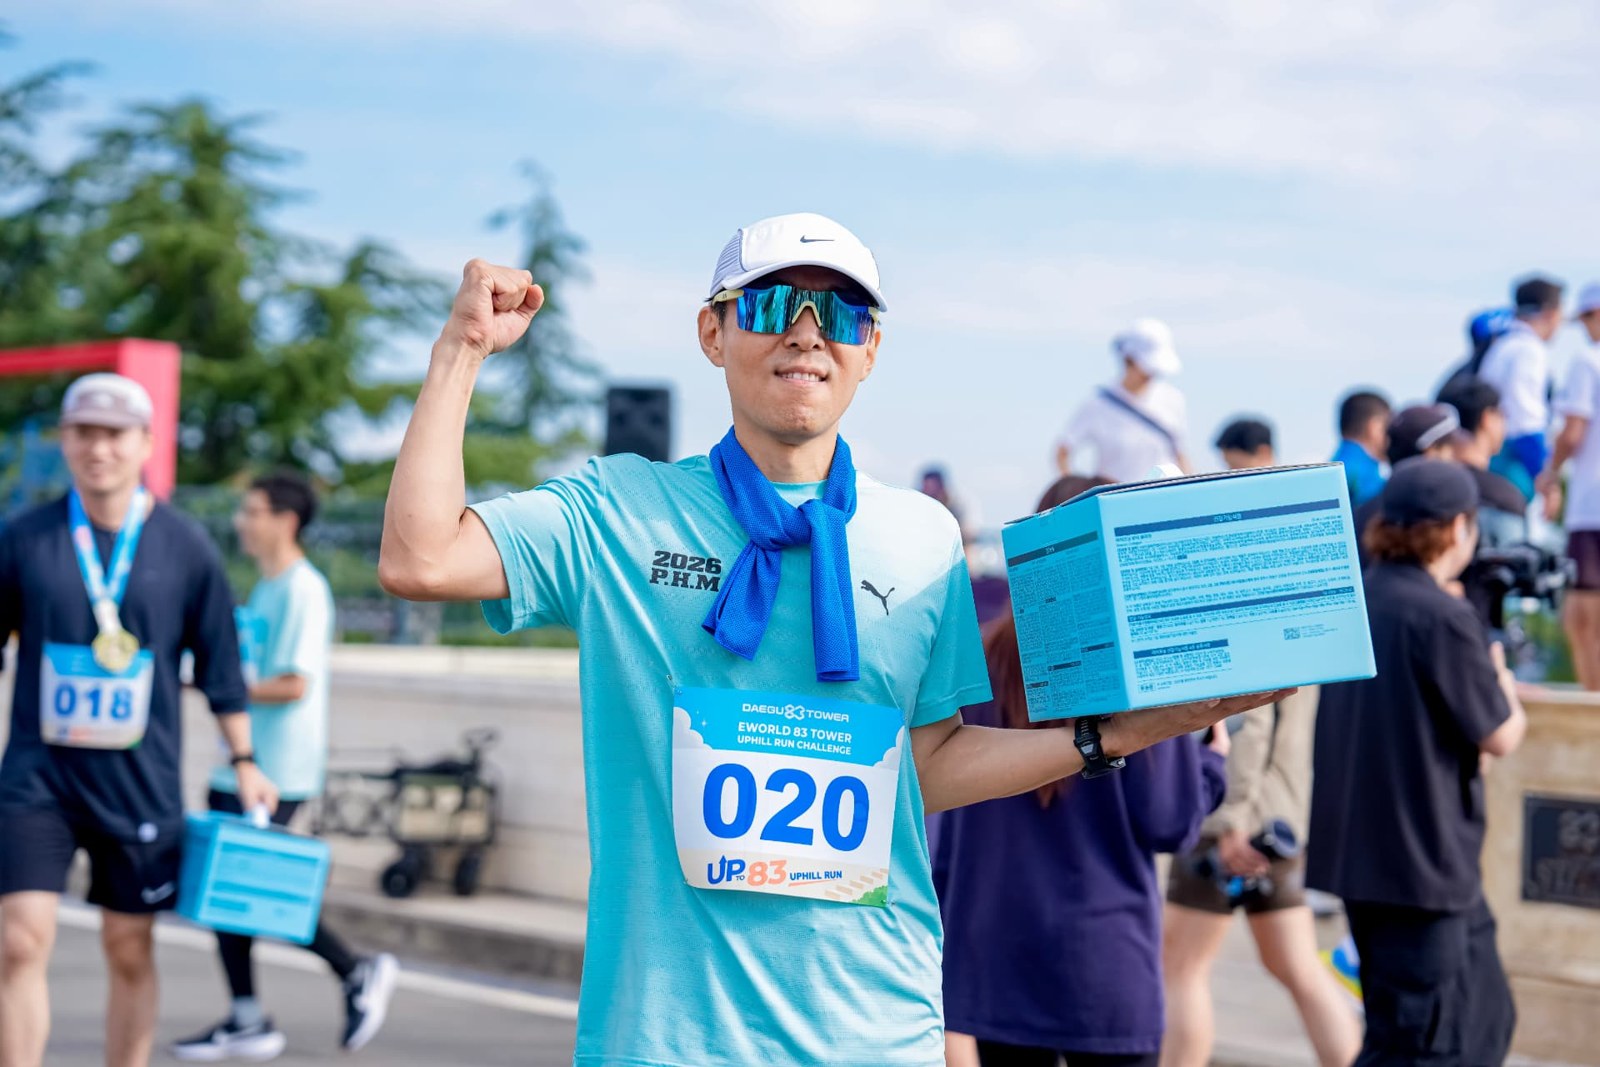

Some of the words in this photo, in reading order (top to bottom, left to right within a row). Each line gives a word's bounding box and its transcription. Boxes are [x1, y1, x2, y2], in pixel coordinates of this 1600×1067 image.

[652, 551, 722, 575] 2026
[54, 683, 133, 720] 018
[742, 703, 784, 715] DAEGU
[784, 704, 805, 720] 83
[806, 709, 849, 722] TOWER
[738, 721, 791, 736] EWORLD
[793, 726, 808, 738] 83
[810, 728, 852, 743] TOWER
[737, 735, 772, 746] UPHILL
[774, 738, 795, 748] RUN
[796, 740, 852, 755] CHALLENGE
[702, 763, 870, 852] 020
[707, 855, 746, 885] UP
[747, 860, 787, 887] 83
[789, 871, 821, 881] UPHILL
[824, 870, 843, 879] RUN
